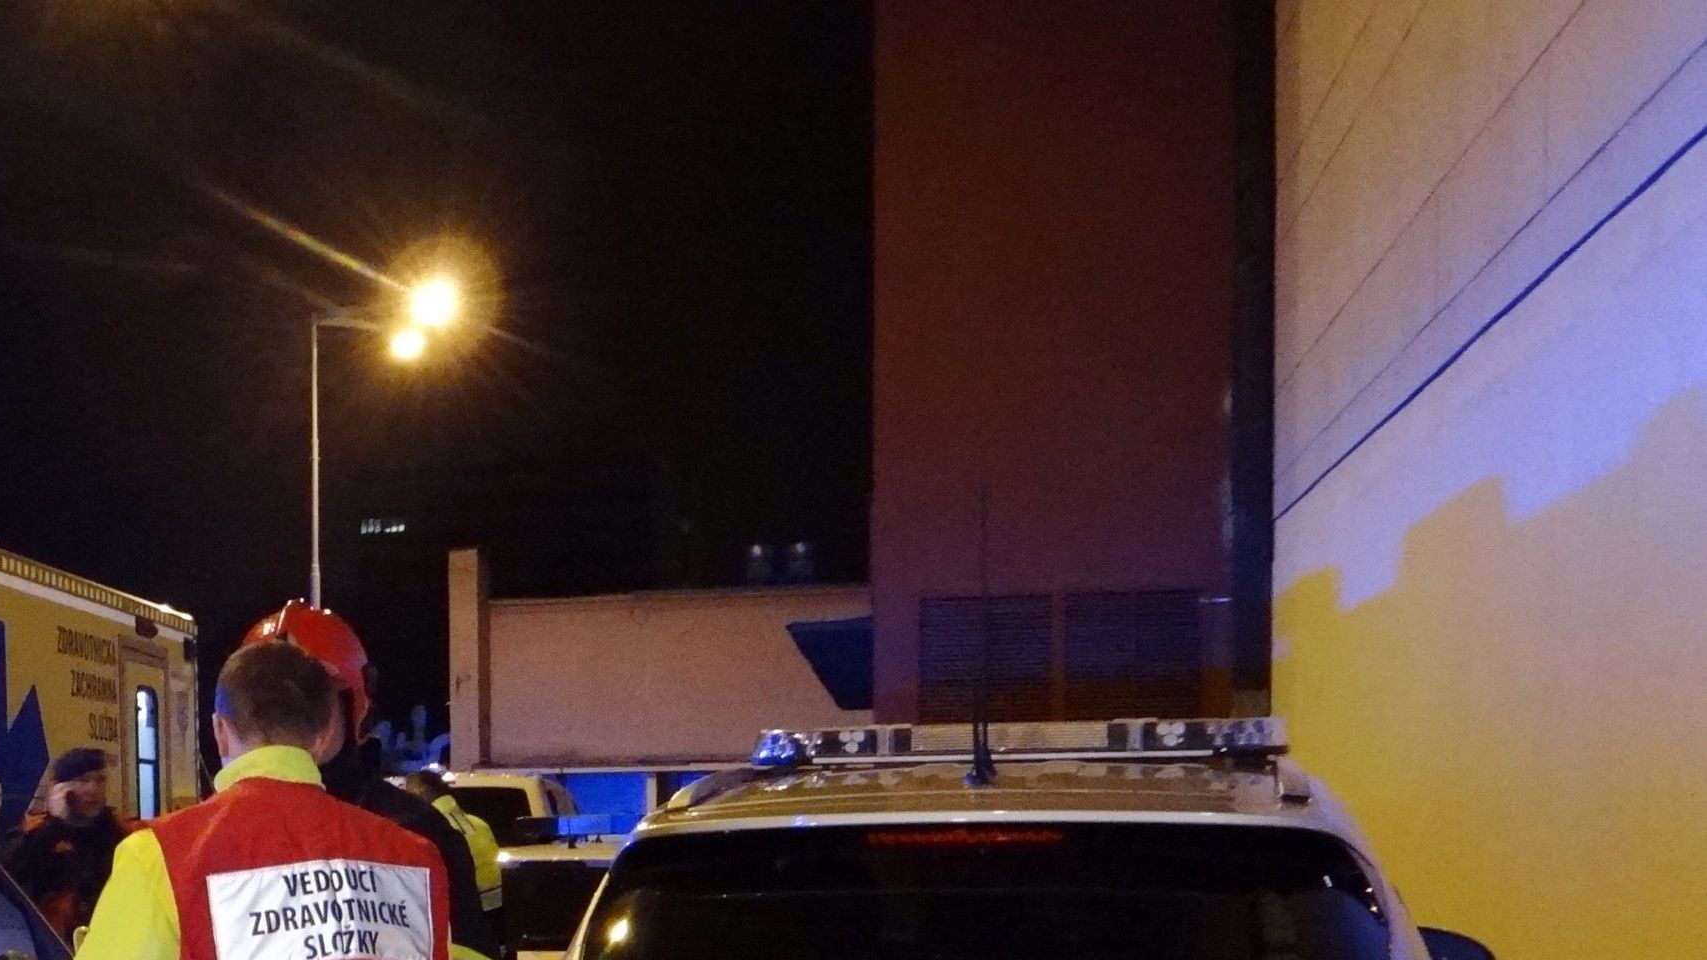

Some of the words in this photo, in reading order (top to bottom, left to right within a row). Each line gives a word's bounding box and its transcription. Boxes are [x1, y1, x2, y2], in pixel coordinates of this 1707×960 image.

[283, 866, 378, 898] VEDOUCÍ
[249, 898, 411, 937] ZDRAVOTNICKÉ
[304, 925, 380, 960] SLOŽKY
